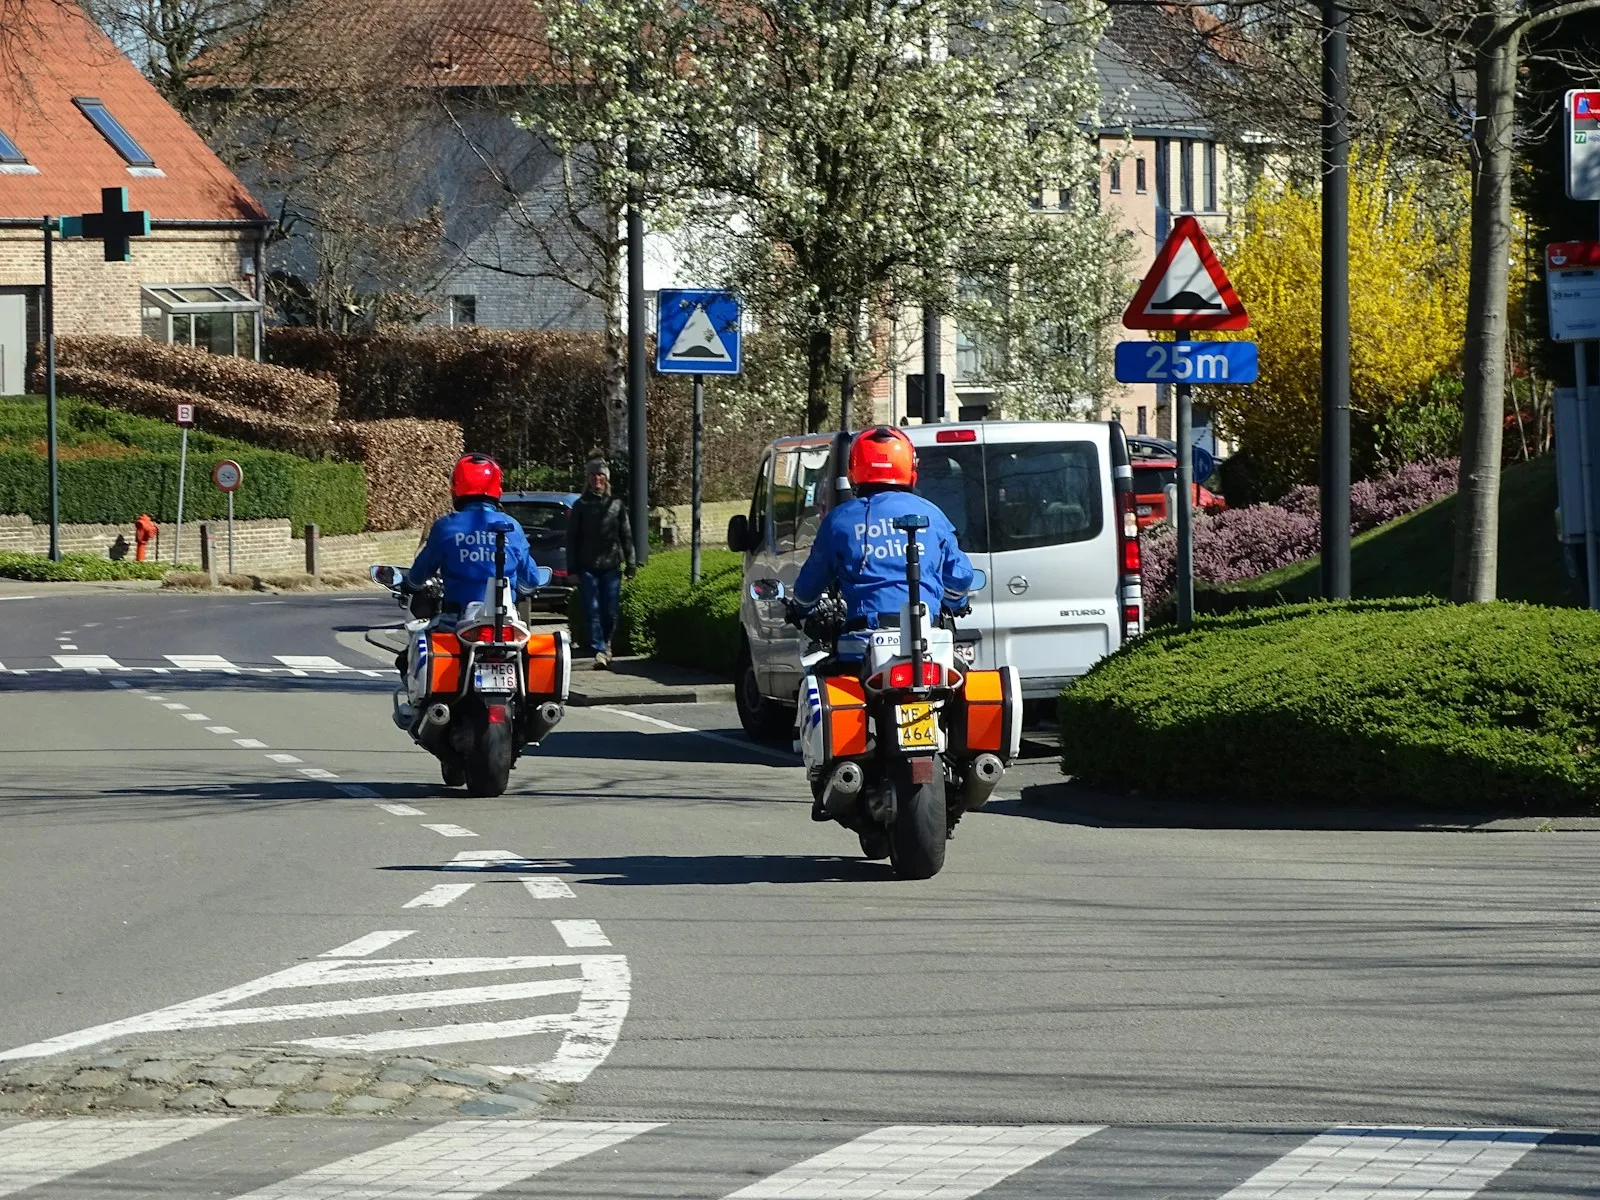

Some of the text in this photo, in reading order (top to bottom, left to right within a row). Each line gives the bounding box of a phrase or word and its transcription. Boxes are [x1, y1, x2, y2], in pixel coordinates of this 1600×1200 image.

[1575, 133, 1586, 142] 77
[1146, 345, 1229, 380] 25m
[180, 407, 190, 419] B
[854, 517, 927, 541] Poli
[455, 530, 510, 547] Polite
[460, 547, 508, 563] Polic
[493, 676, 514, 687] 116
[903, 727, 932, 742] 464
